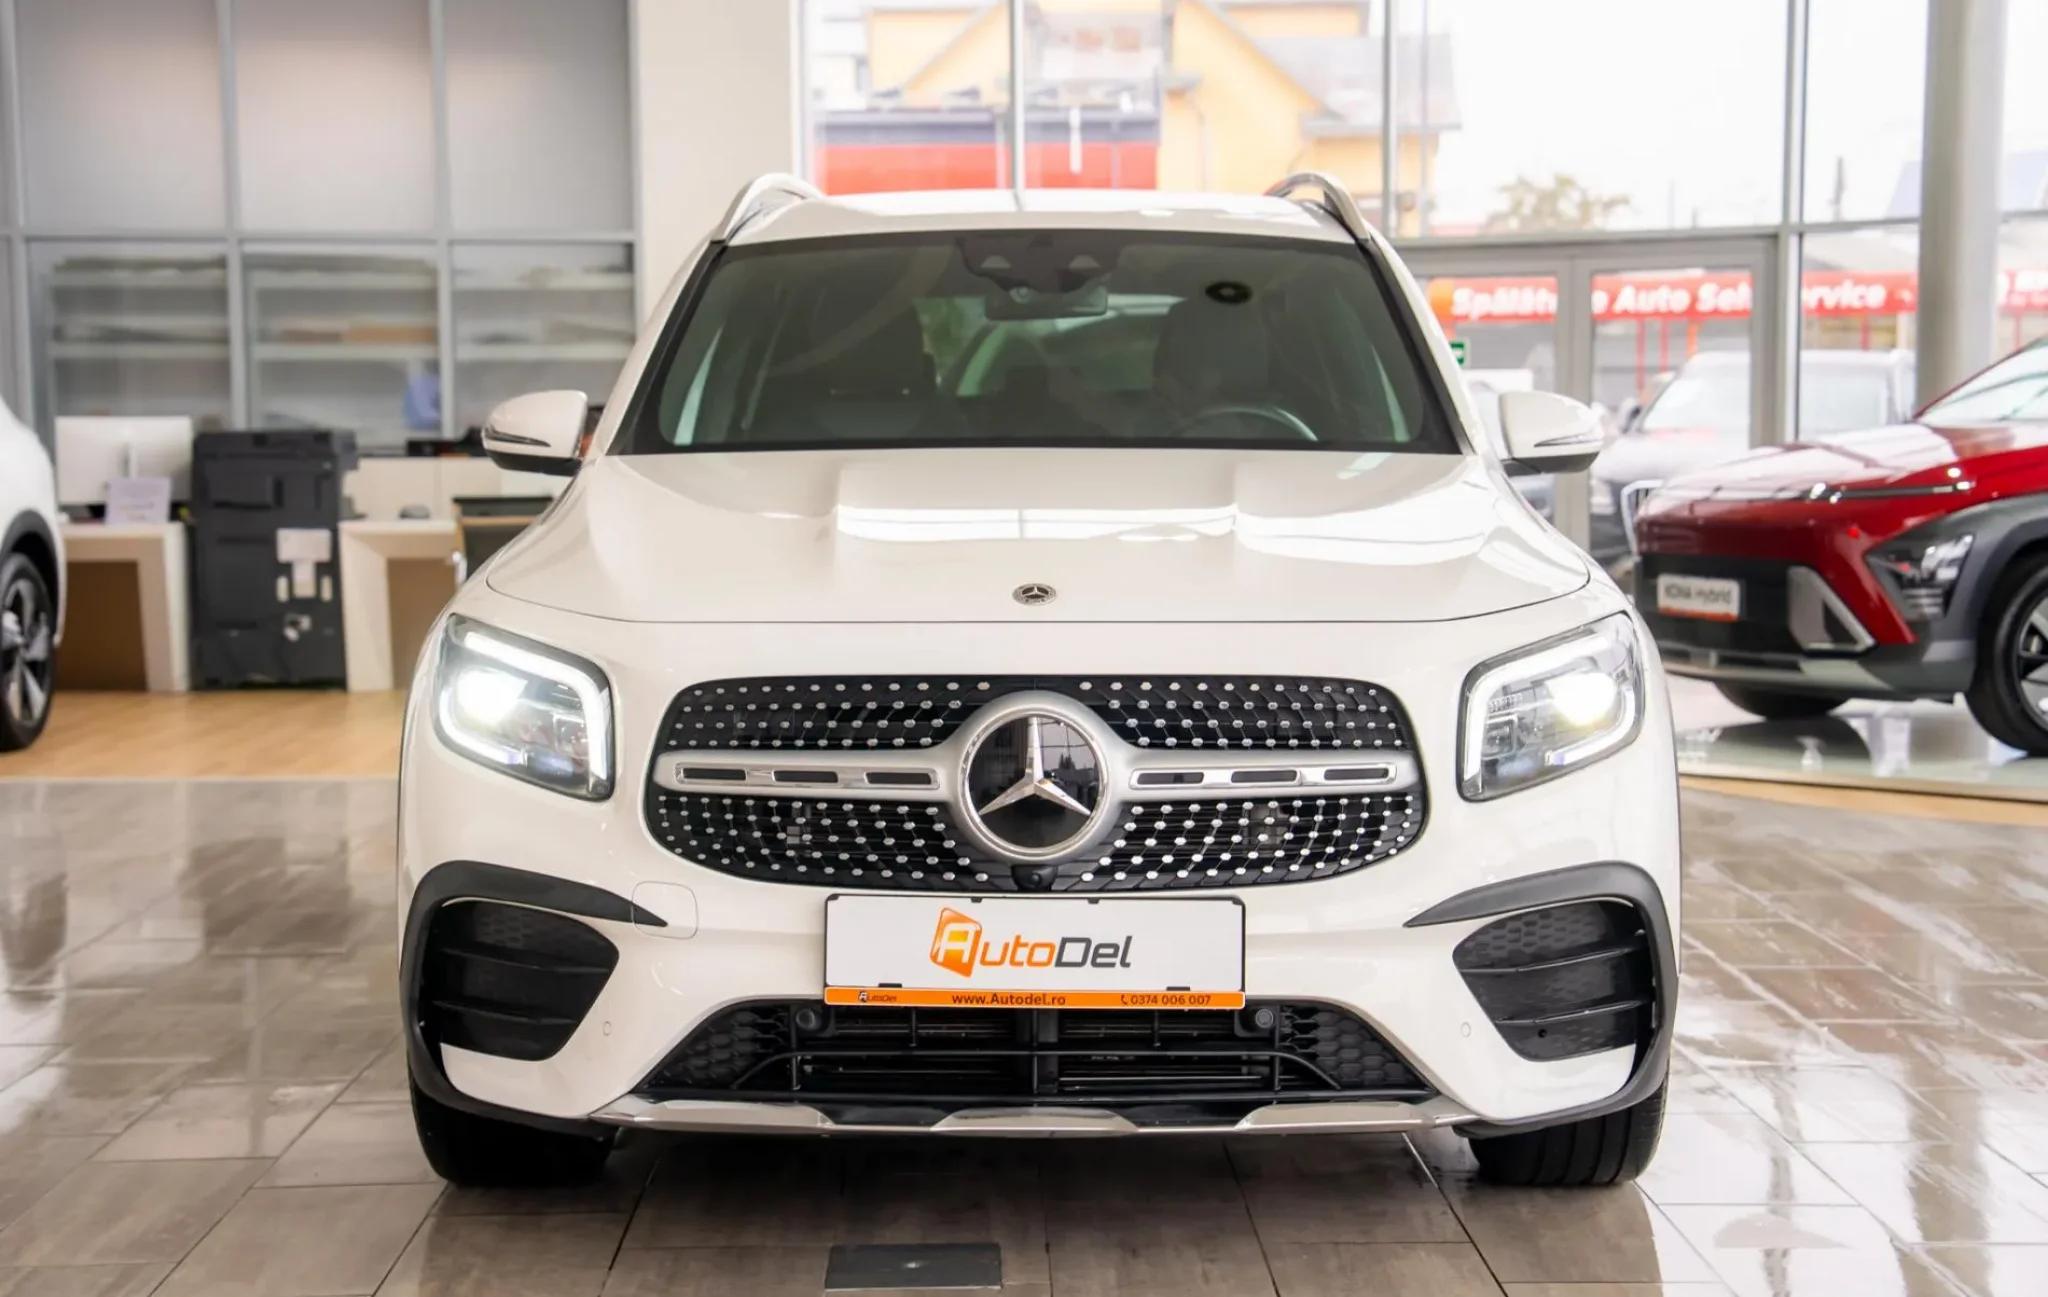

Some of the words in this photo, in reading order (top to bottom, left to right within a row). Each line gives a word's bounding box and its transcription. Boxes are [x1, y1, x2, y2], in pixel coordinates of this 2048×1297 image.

[1612, 284, 1691, 314] Auto
[1695, 281, 1753, 313] Sel
[930, 908, 1133, 978] AutoDel
[952, 992, 1066, 1006] www.Autodel.ro
[1130, 994, 1158, 1006] 0374
[1161, 994, 1185, 1006] 006
[1188, 994, 1211, 1006] 007
